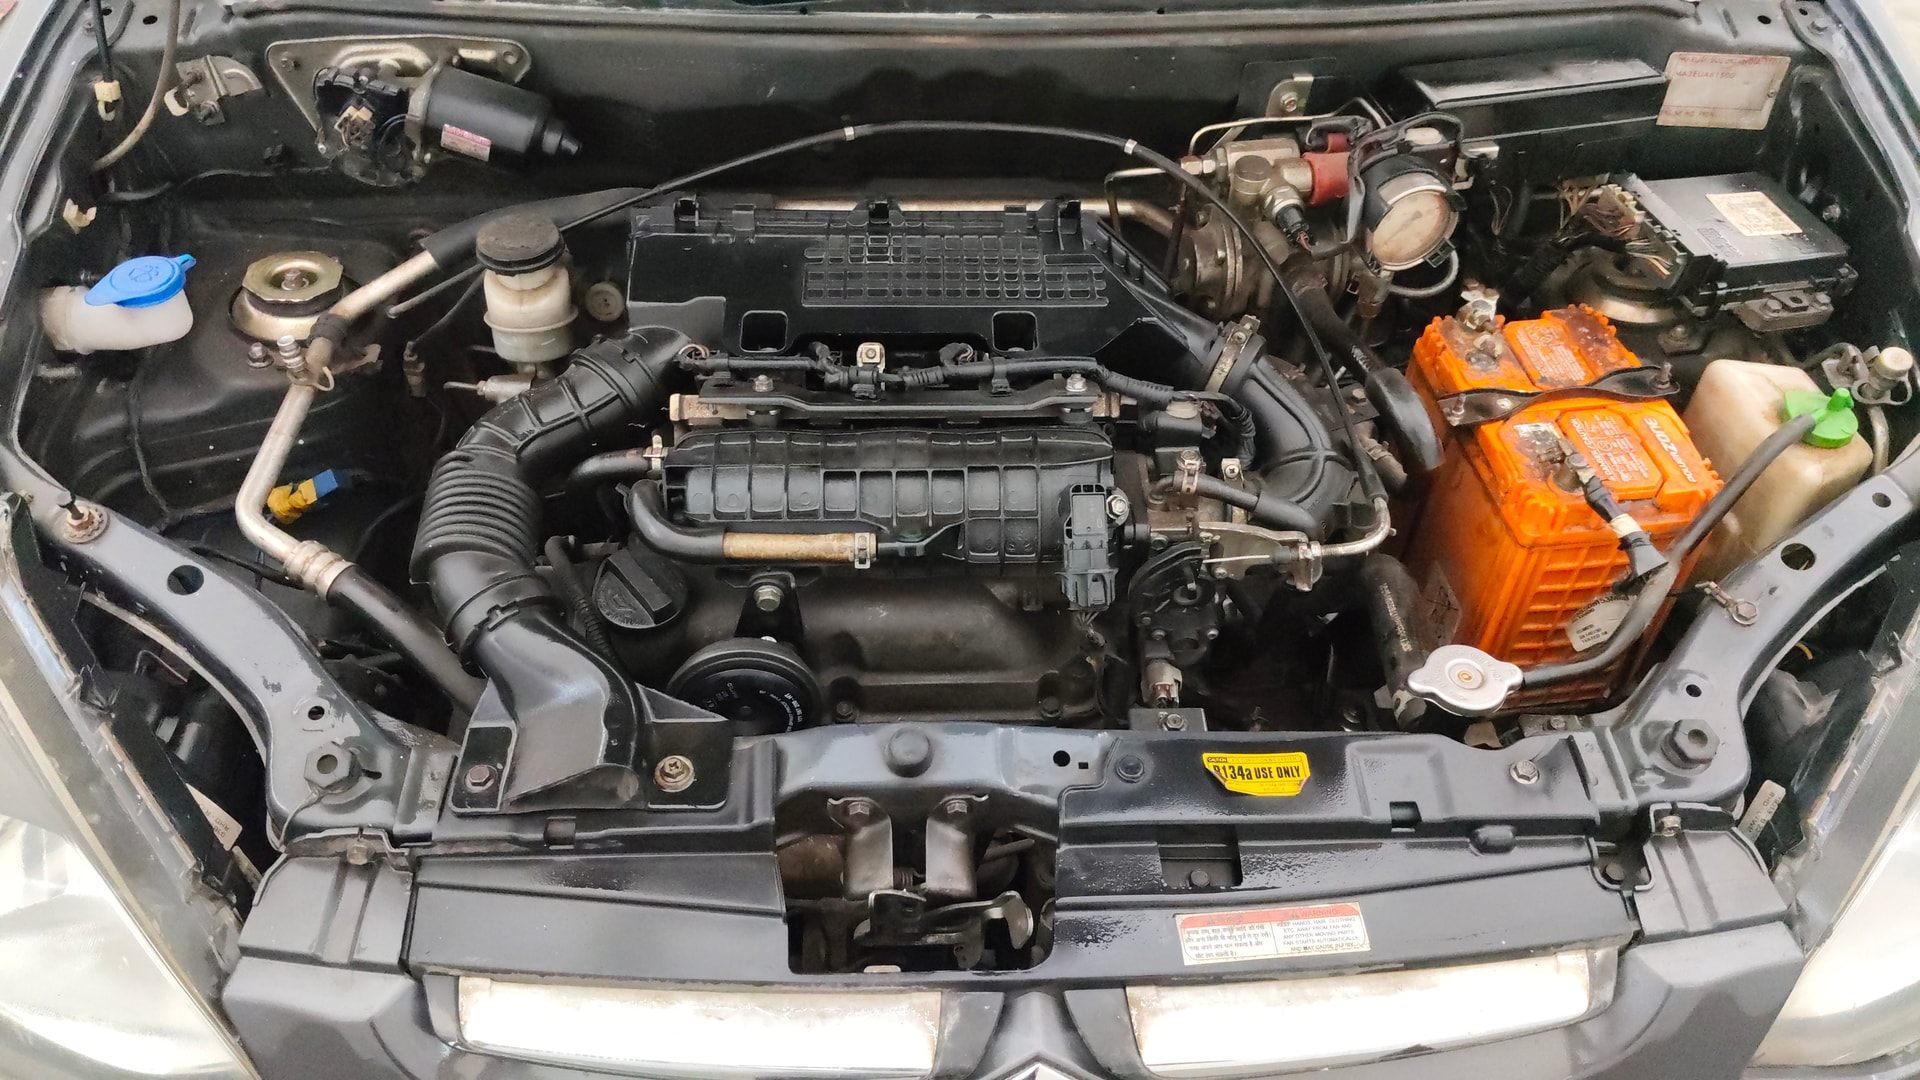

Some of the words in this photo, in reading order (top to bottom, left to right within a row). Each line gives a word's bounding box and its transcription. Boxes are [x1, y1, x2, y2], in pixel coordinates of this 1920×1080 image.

[1254, 767, 1274, 780] USE
[1276, 765, 1301, 779] ONLY
[1301, 909, 1338, 917] WARNING
